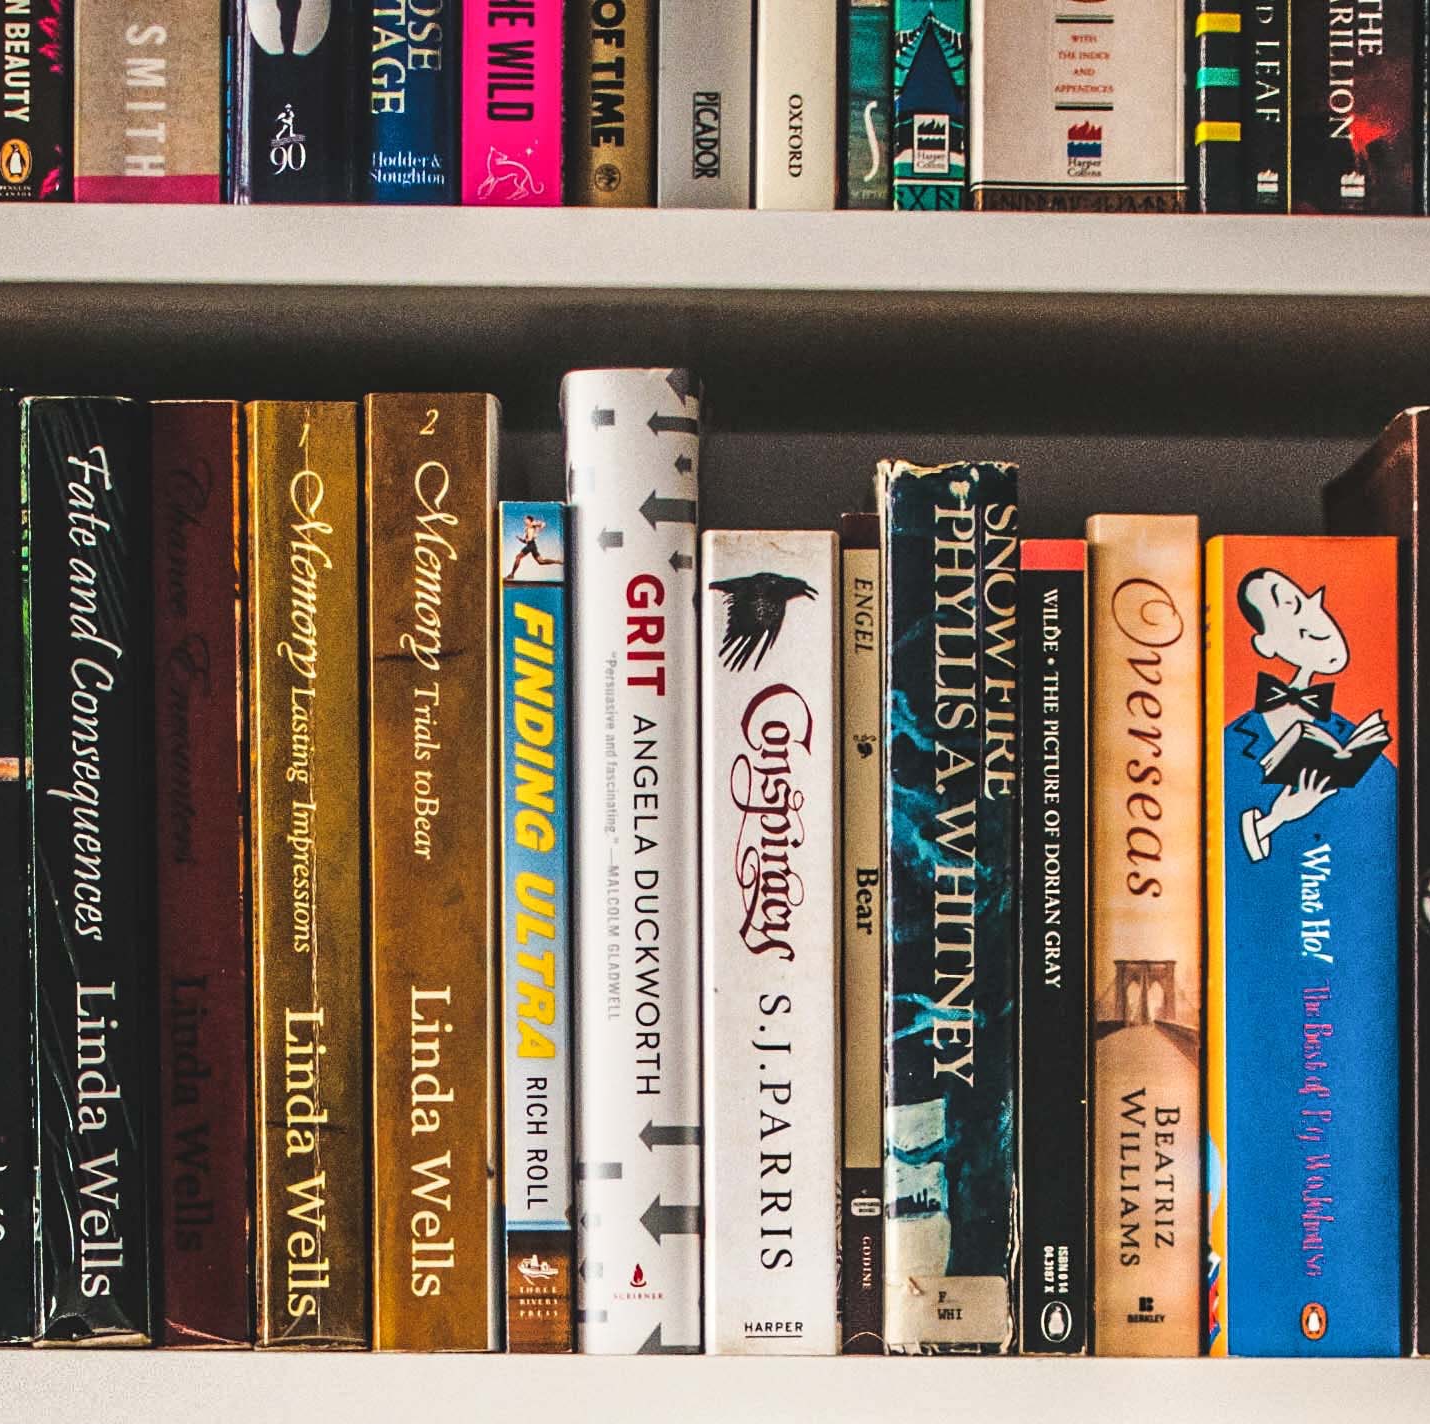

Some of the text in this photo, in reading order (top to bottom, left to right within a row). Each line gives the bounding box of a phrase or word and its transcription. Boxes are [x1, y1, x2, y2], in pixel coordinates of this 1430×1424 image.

[3, 23, 31, 123] BEAUTY
[125, 24, 166, 178] SMITH
[488, 40, 534, 122] WILD
[591, 57, 624, 147] TIME
[1255, 47, 1280, 123] LEAF
[694, 91, 722, 179] PICADOR
[788, 94, 802, 178] OXFORD
[1043, 588, 1062, 988] WILDE THE PICTURE OF DORIAN GRAY
[1111, 577, 1184, 899] Overseas
[626, 572, 666, 1096] GRIT ANGELA DUCKWORTH
[514, 602, 556, 1210] FINDING ULTRA RICH ROLL
[856, 867, 873, 935] Bear
[76, 981, 123, 1298] Linda Wells
[1119, 1087, 1146, 1268] WILLIAMS
[1153, 1106, 1180, 1249] BEATRIZ
[744, 1322, 803, 1333] HARPER
